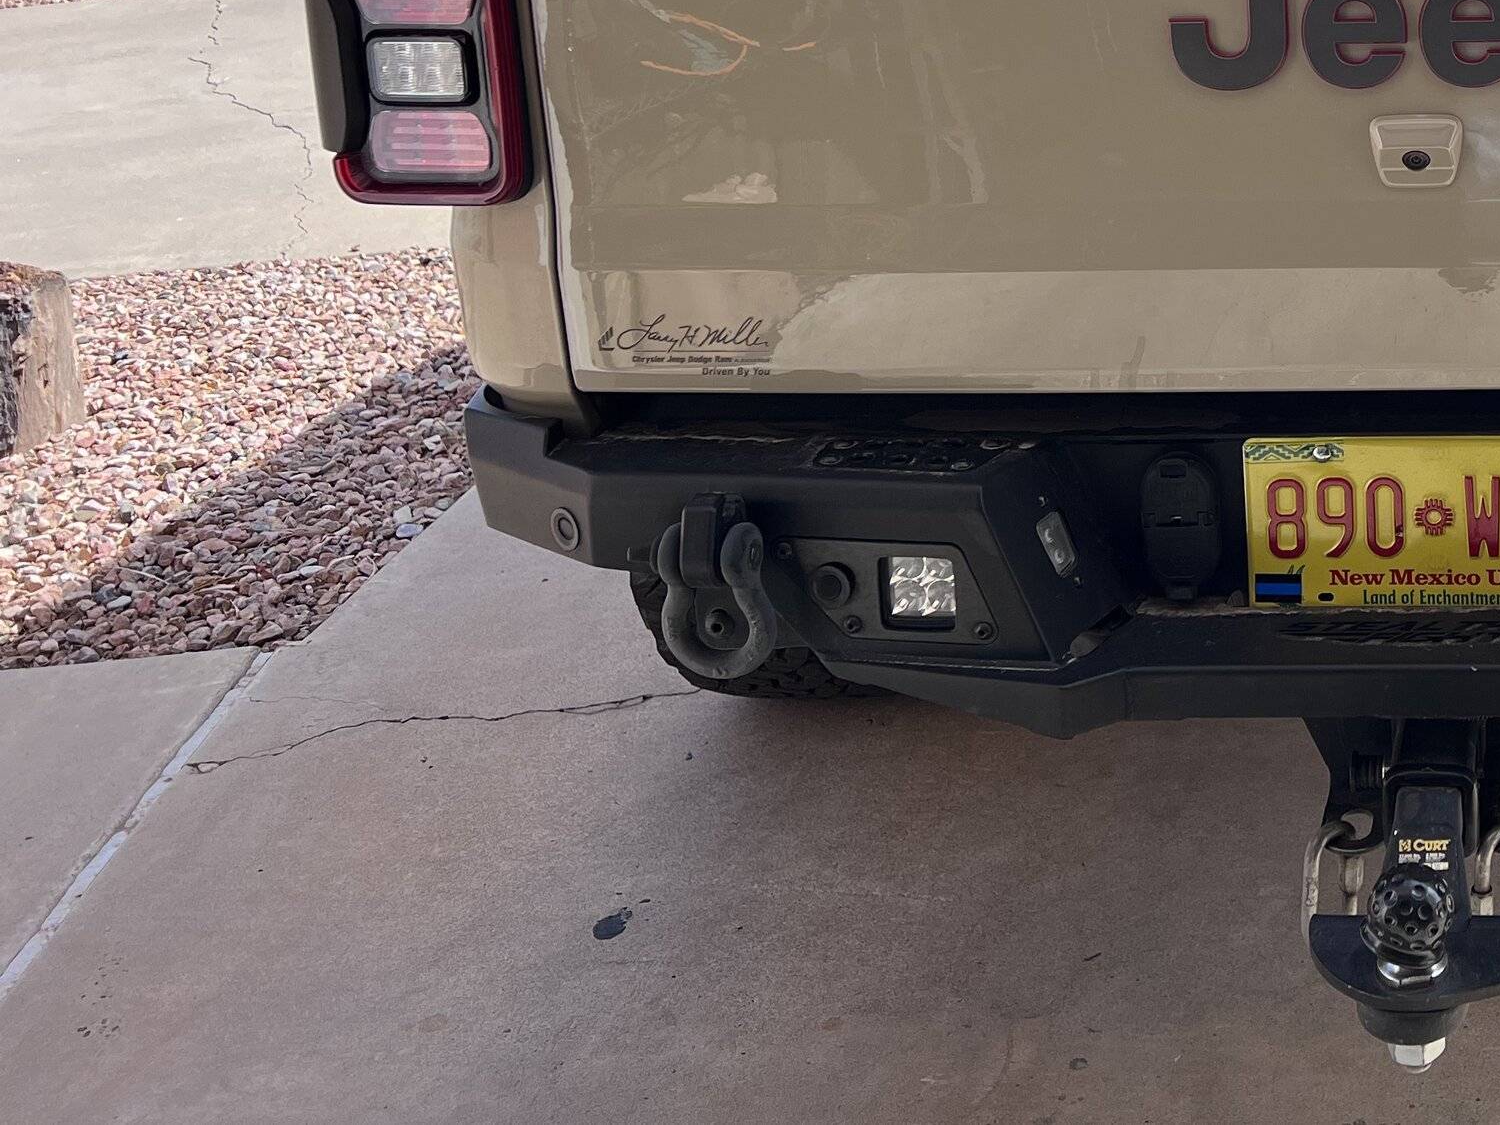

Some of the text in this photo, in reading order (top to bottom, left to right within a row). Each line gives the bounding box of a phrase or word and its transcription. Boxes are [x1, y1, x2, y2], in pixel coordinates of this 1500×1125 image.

[697, 316, 769, 347] Miller
[632, 355, 664, 363] Chrysler
[688, 355, 712, 363] Dodge
[702, 368, 770, 377] Driven By You
[1267, 476, 1407, 558] 890
[1329, 569, 1384, 586] New
[1389, 569, 1481, 586] Mexico
[1363, 589, 1396, 605] Land
[1401, 589, 1414, 605] of
[1413, 839, 1450, 852] CURT
